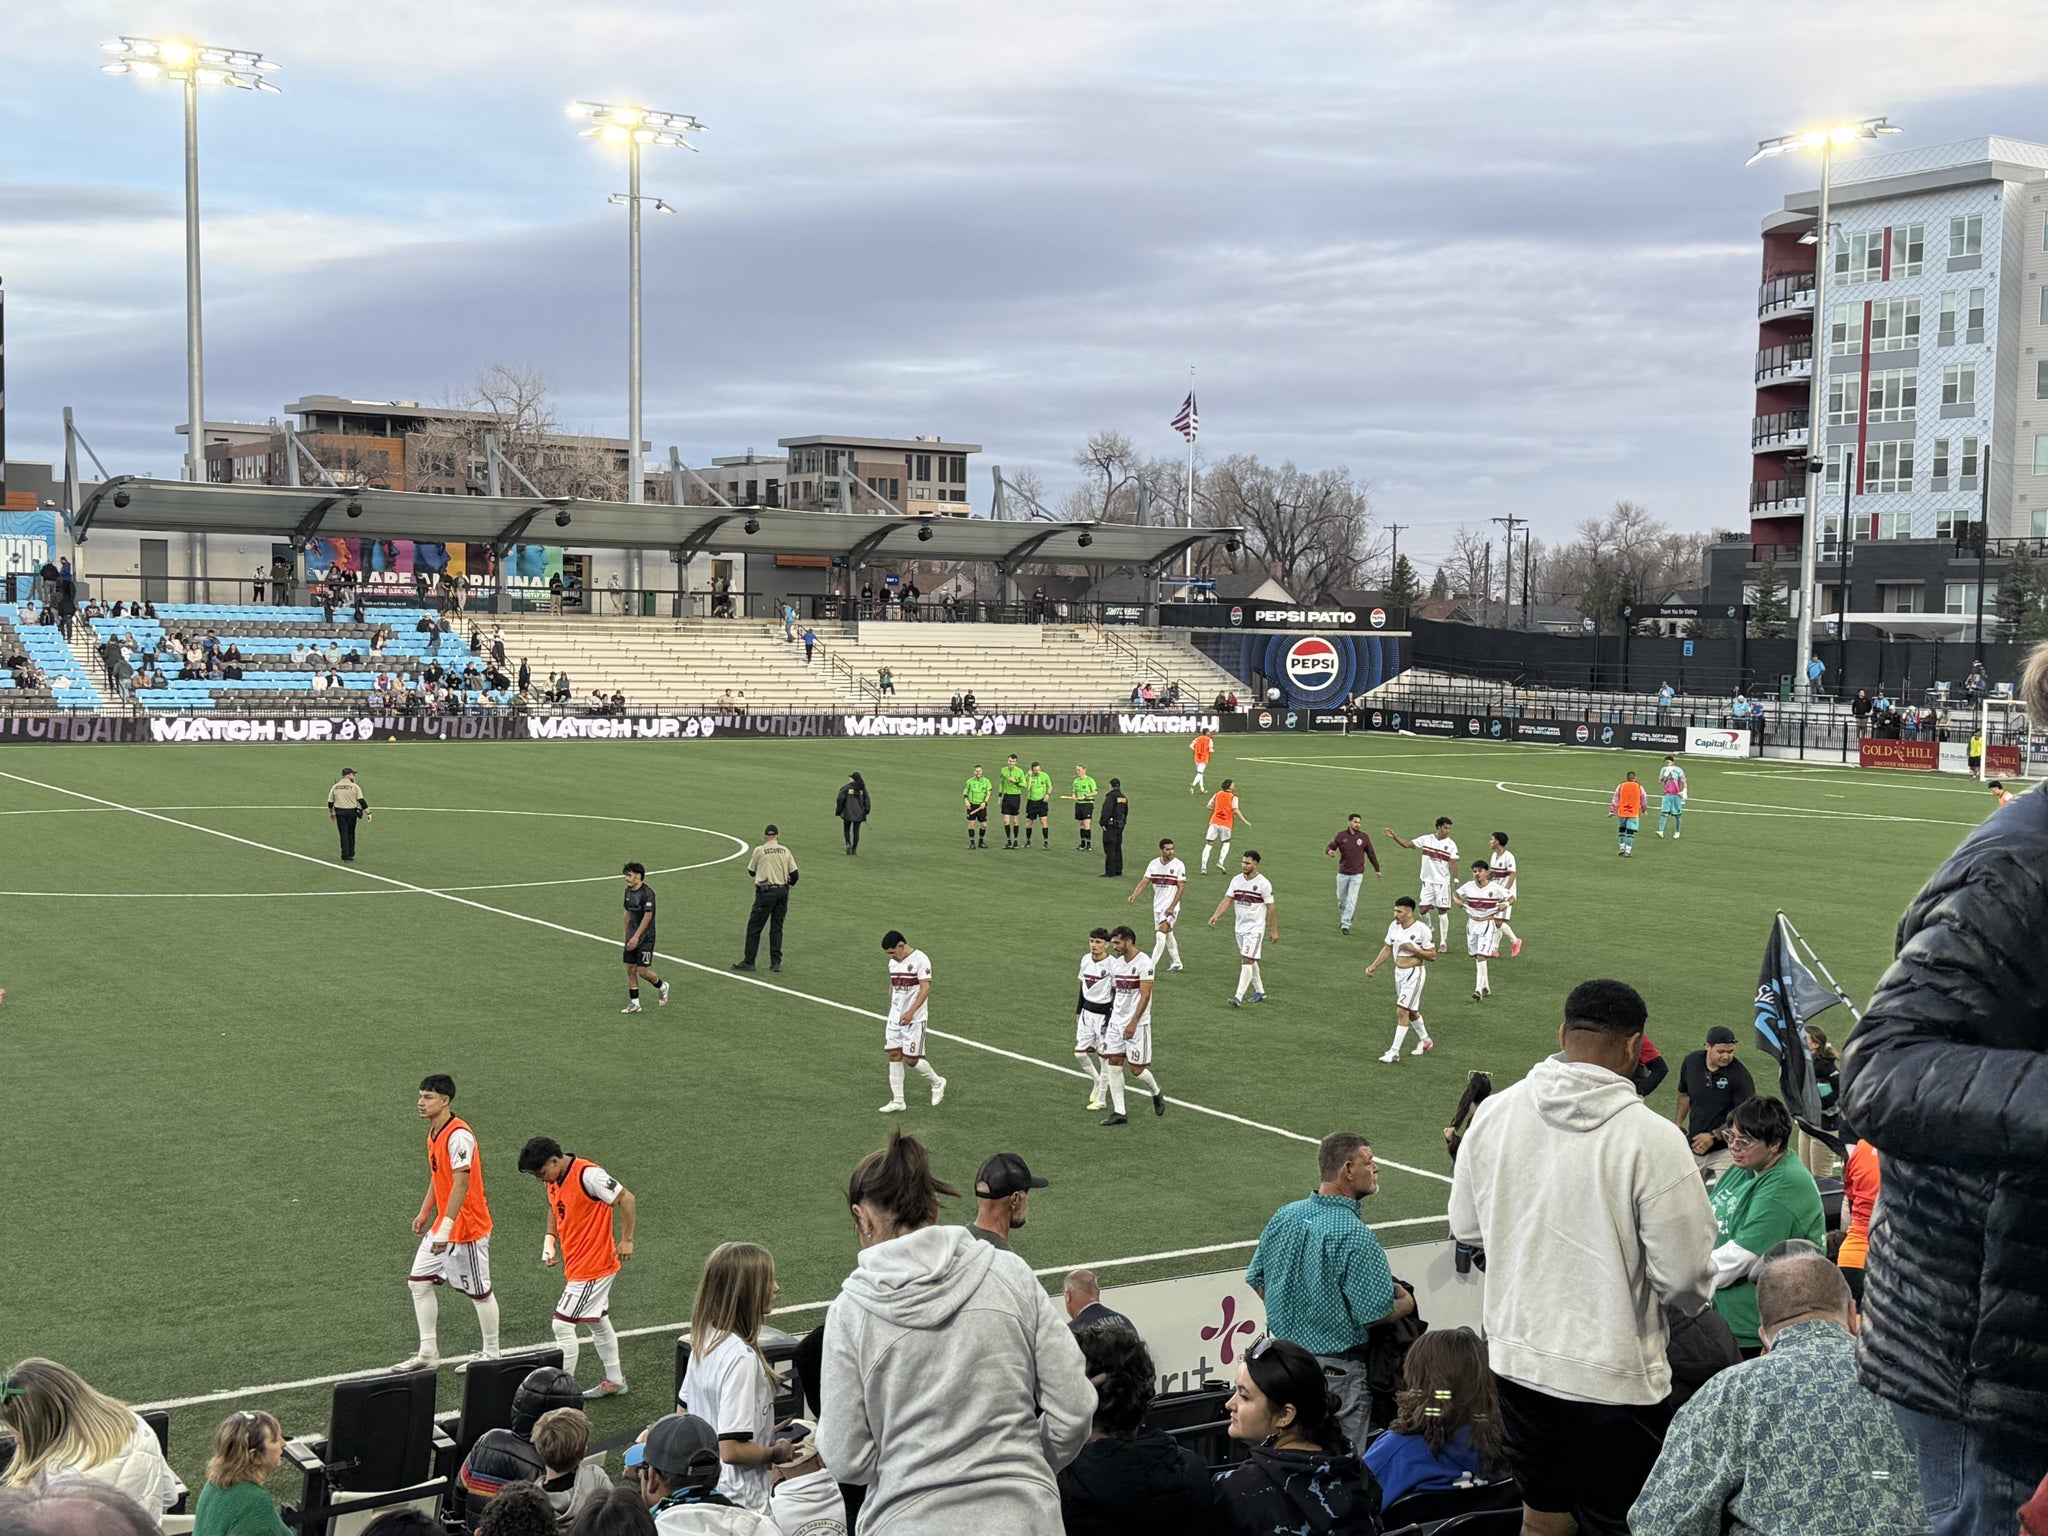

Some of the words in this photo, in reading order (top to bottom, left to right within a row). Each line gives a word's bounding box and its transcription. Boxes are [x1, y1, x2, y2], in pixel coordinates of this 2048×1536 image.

[1255, 611, 1306, 623] PEPSI
[1307, 612, 1356, 623] PATIO
[1291, 659, 1335, 669] PEPSI
[1695, 739, 1725, 748] Capital
[1862, 744, 1893, 756] GOLD
[1906, 747, 1933, 759] HILL
[1245, 945, 1250, 954] 3
[641, 952, 651, 964] 70
[1399, 994, 1407, 1004] 2
[910, 1042, 916, 1053] 8
[1131, 1050, 1140, 1062] 19
[460, 1275, 470, 1290] 5
